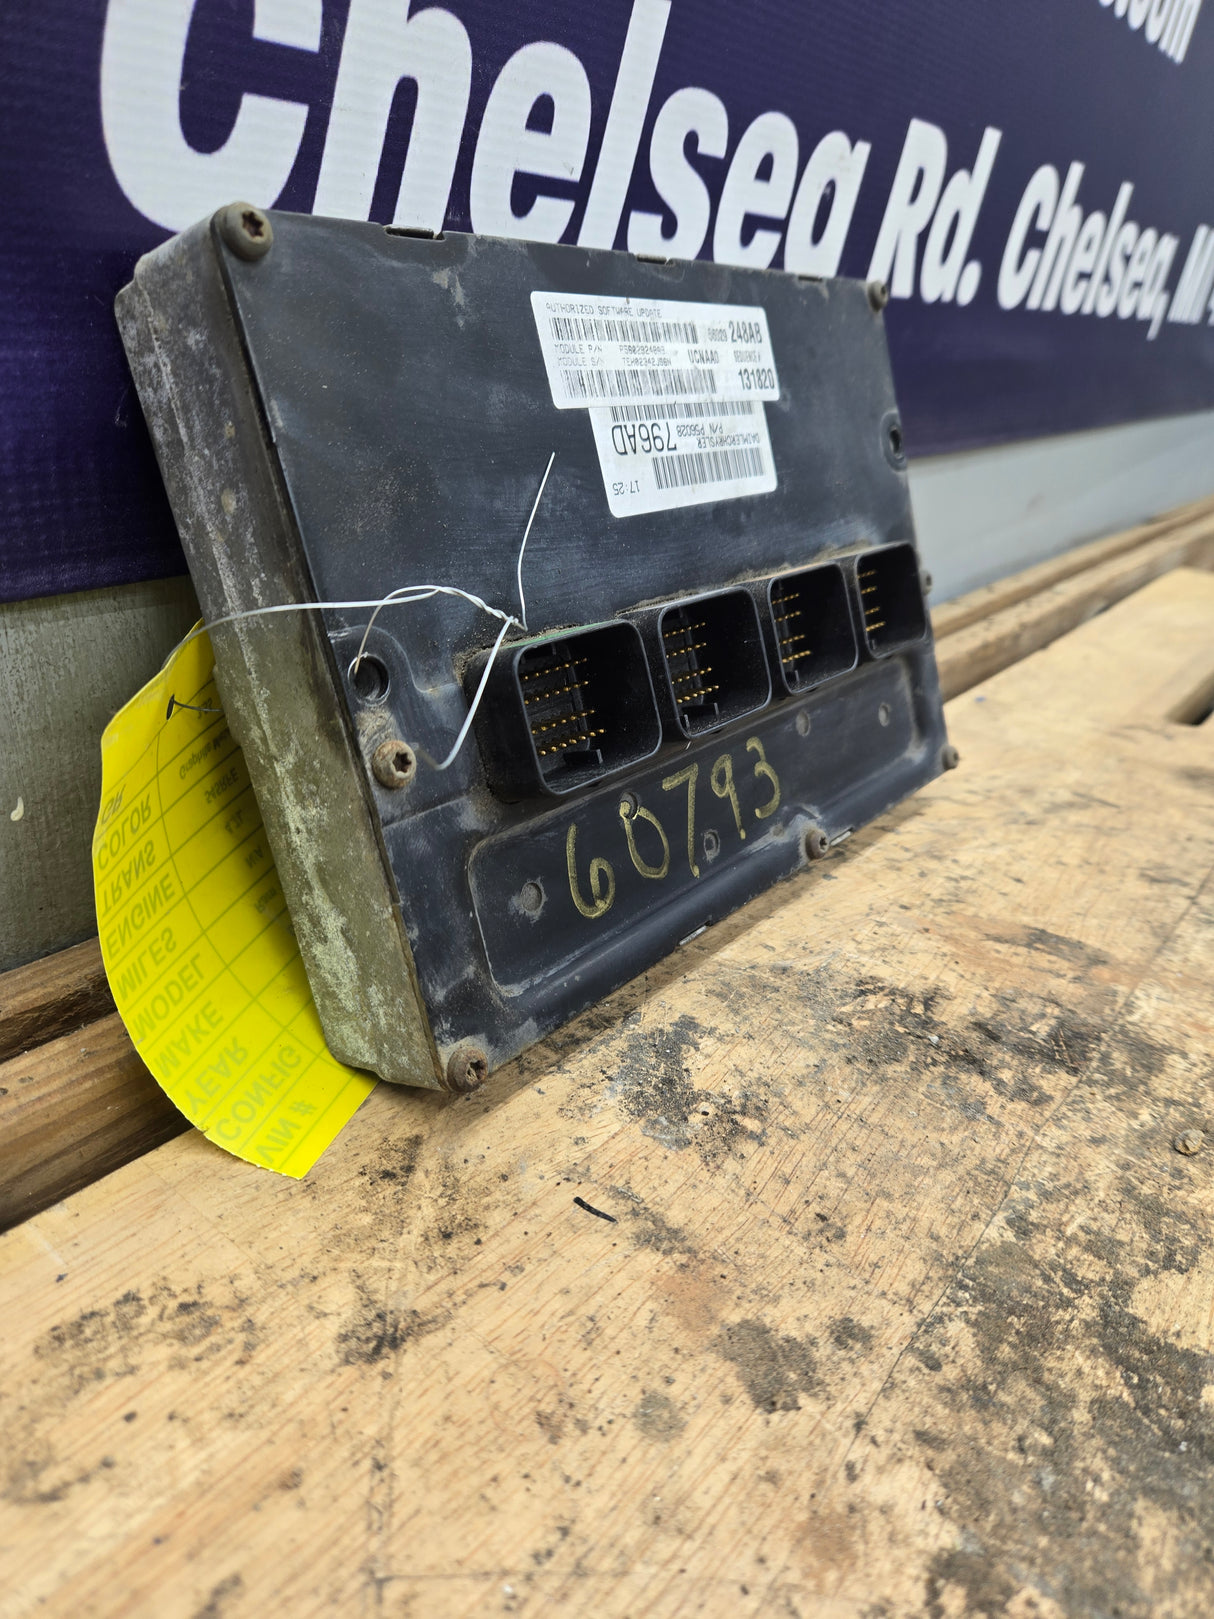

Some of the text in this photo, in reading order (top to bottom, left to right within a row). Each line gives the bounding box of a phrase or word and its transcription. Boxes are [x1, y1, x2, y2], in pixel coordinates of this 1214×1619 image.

[100, 0, 872, 278] Chelsea
[866, 118, 1002, 306] Rd.
[997, 160, 1180, 341] Chelsea,
[545, 302, 662, 319] AUTHORIZED SOFTWARE UPDATE
[728, 320, 763, 344] 248AB
[554, 343, 585, 354] MODULE
[557, 357, 588, 368] MODULE
[738, 367, 776, 391] 131820
[611, 422, 677, 456] 796AD
[612, 480, 640, 496] 17:25
[566, 736, 782, 918] 60793
